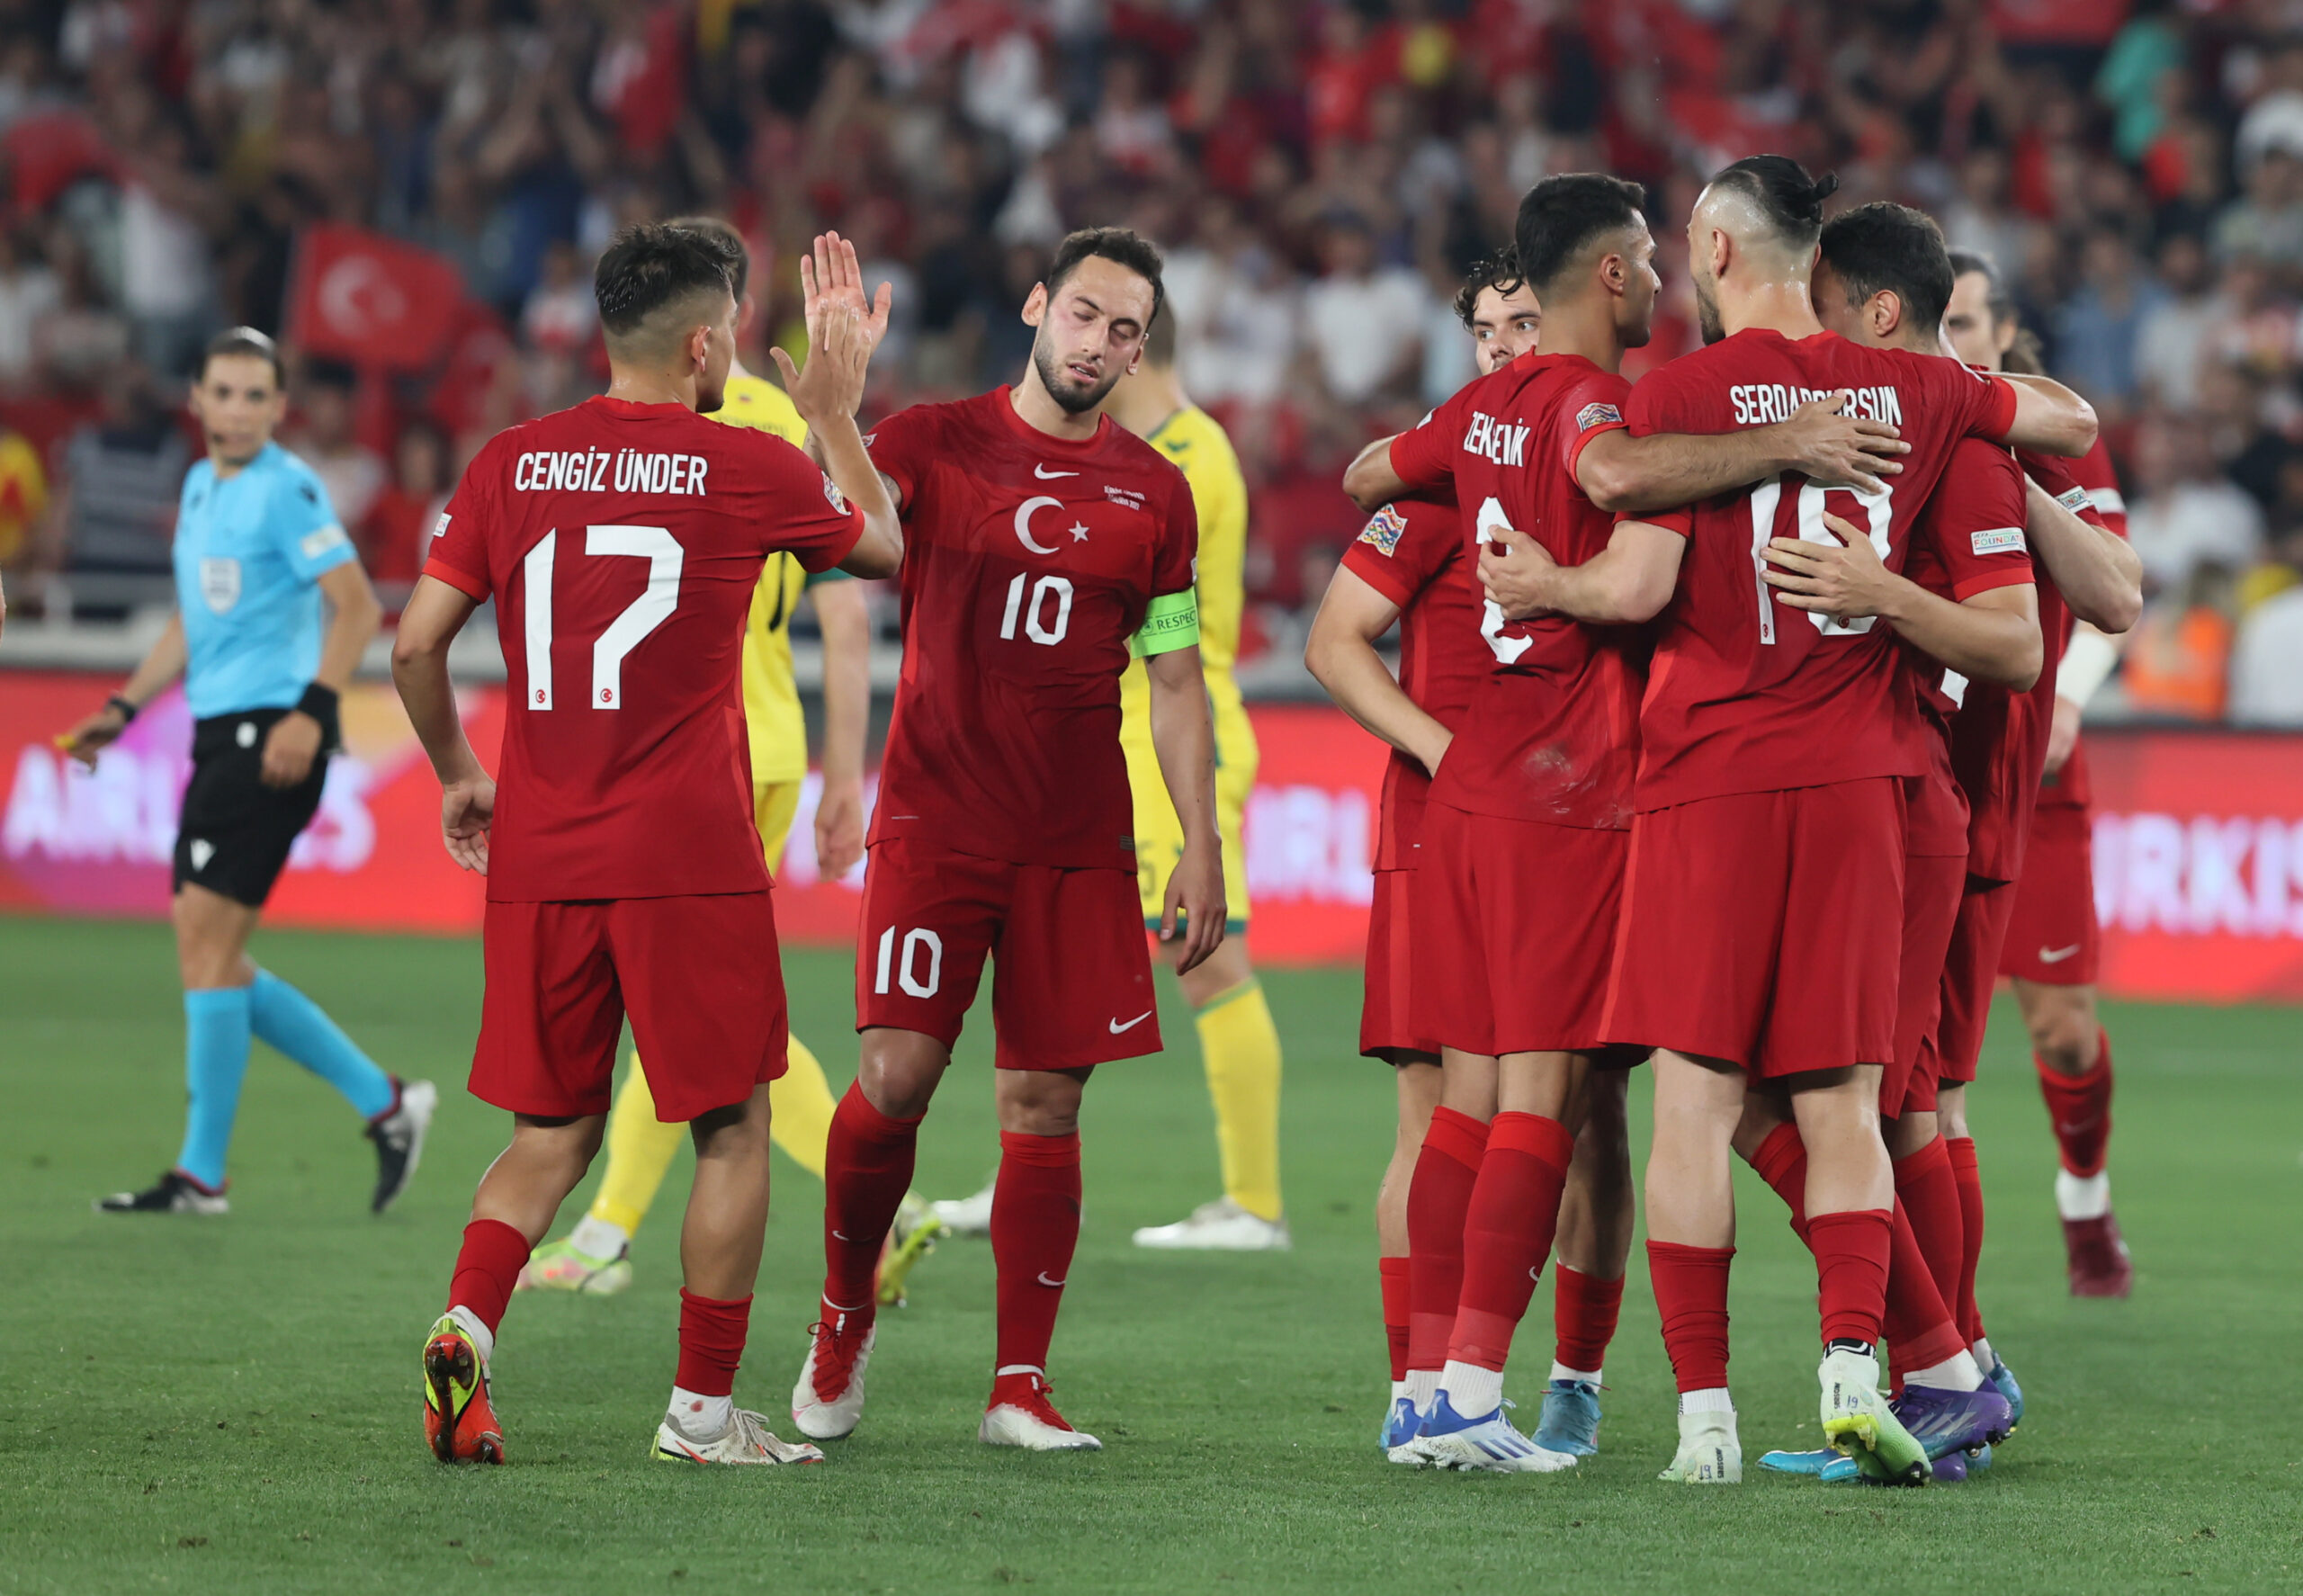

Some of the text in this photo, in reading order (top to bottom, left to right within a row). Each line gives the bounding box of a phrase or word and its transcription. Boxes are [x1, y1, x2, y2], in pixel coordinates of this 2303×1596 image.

[515, 446, 708, 496] CENGİZ ÜNDER
[524, 525, 685, 711] 17
[999, 571, 1074, 646] 10
[1156, 609, 1196, 631] RESPEC
[874, 925, 943, 1000] 10
